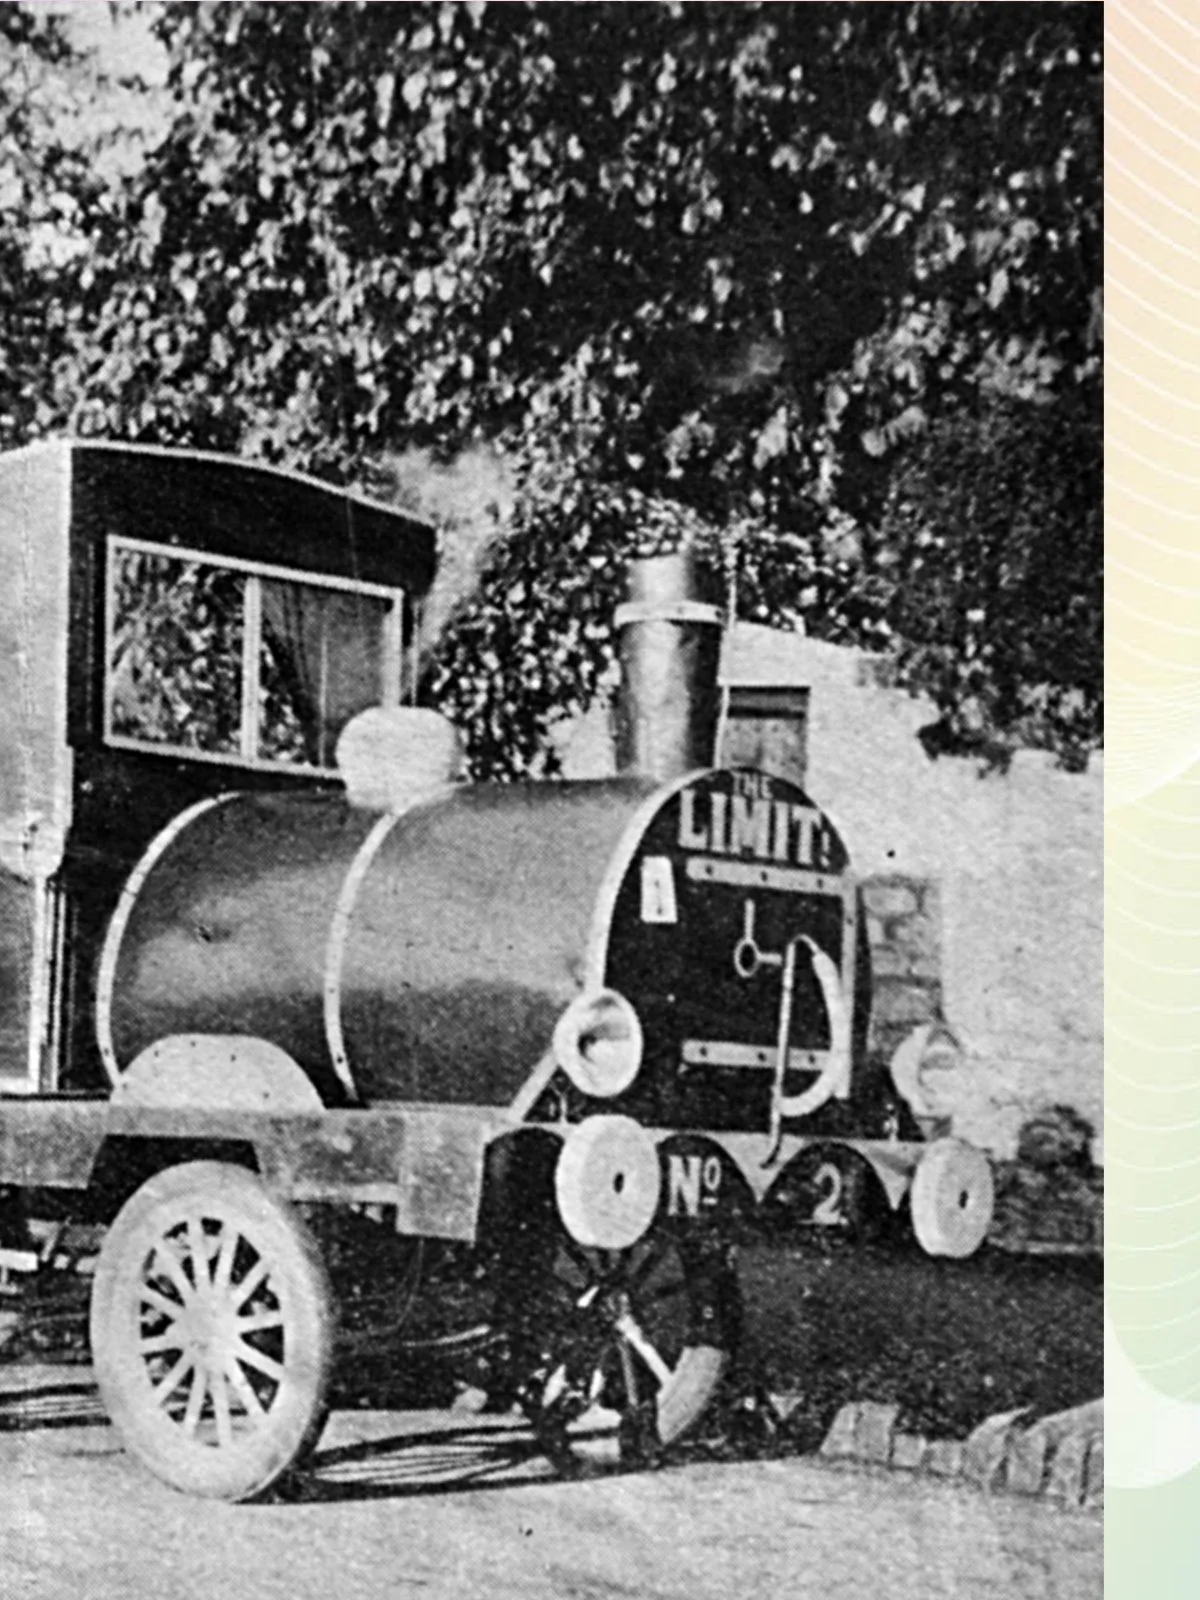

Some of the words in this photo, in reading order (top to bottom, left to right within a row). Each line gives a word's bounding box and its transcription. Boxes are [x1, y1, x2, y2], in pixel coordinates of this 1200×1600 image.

[731, 772, 773, 799] THE
[678, 789, 831, 867] LIMIT!
[811, 1162, 843, 1225] 2
